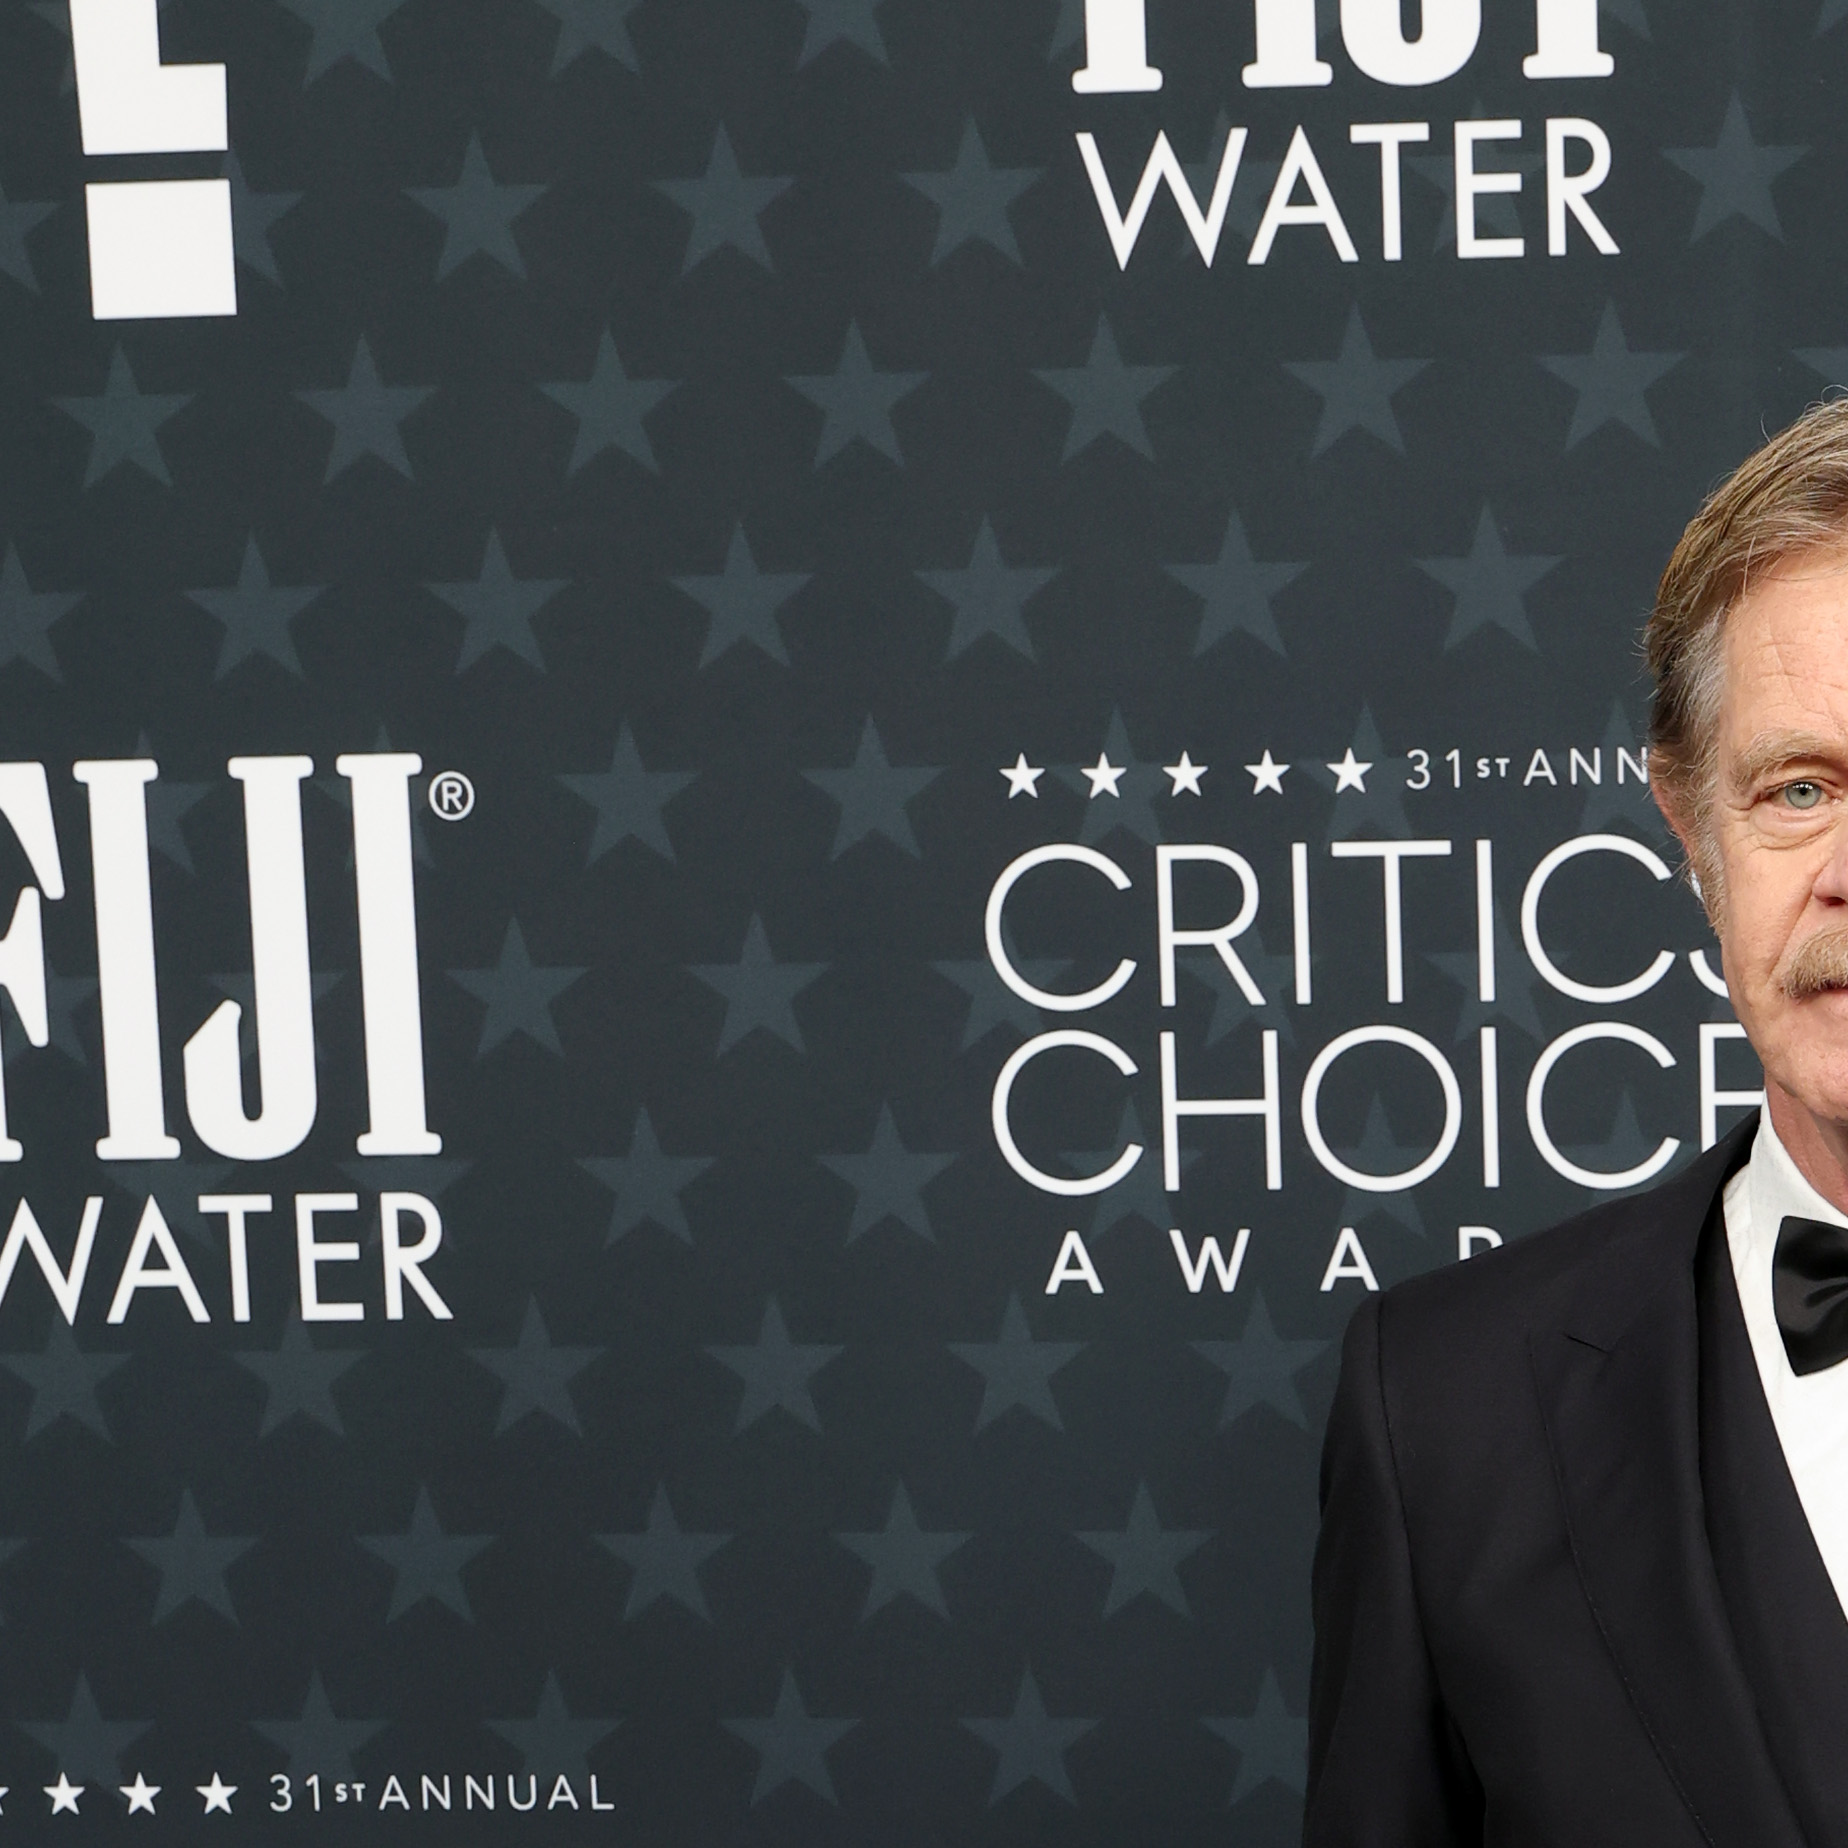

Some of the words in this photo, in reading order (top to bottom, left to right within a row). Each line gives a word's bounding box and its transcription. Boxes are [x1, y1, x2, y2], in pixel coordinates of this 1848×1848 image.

[1075, 117, 1621, 271] WATER
[1523, 746, 1650, 787] ANN
[379, 1774, 615, 1811] ANNUAL
